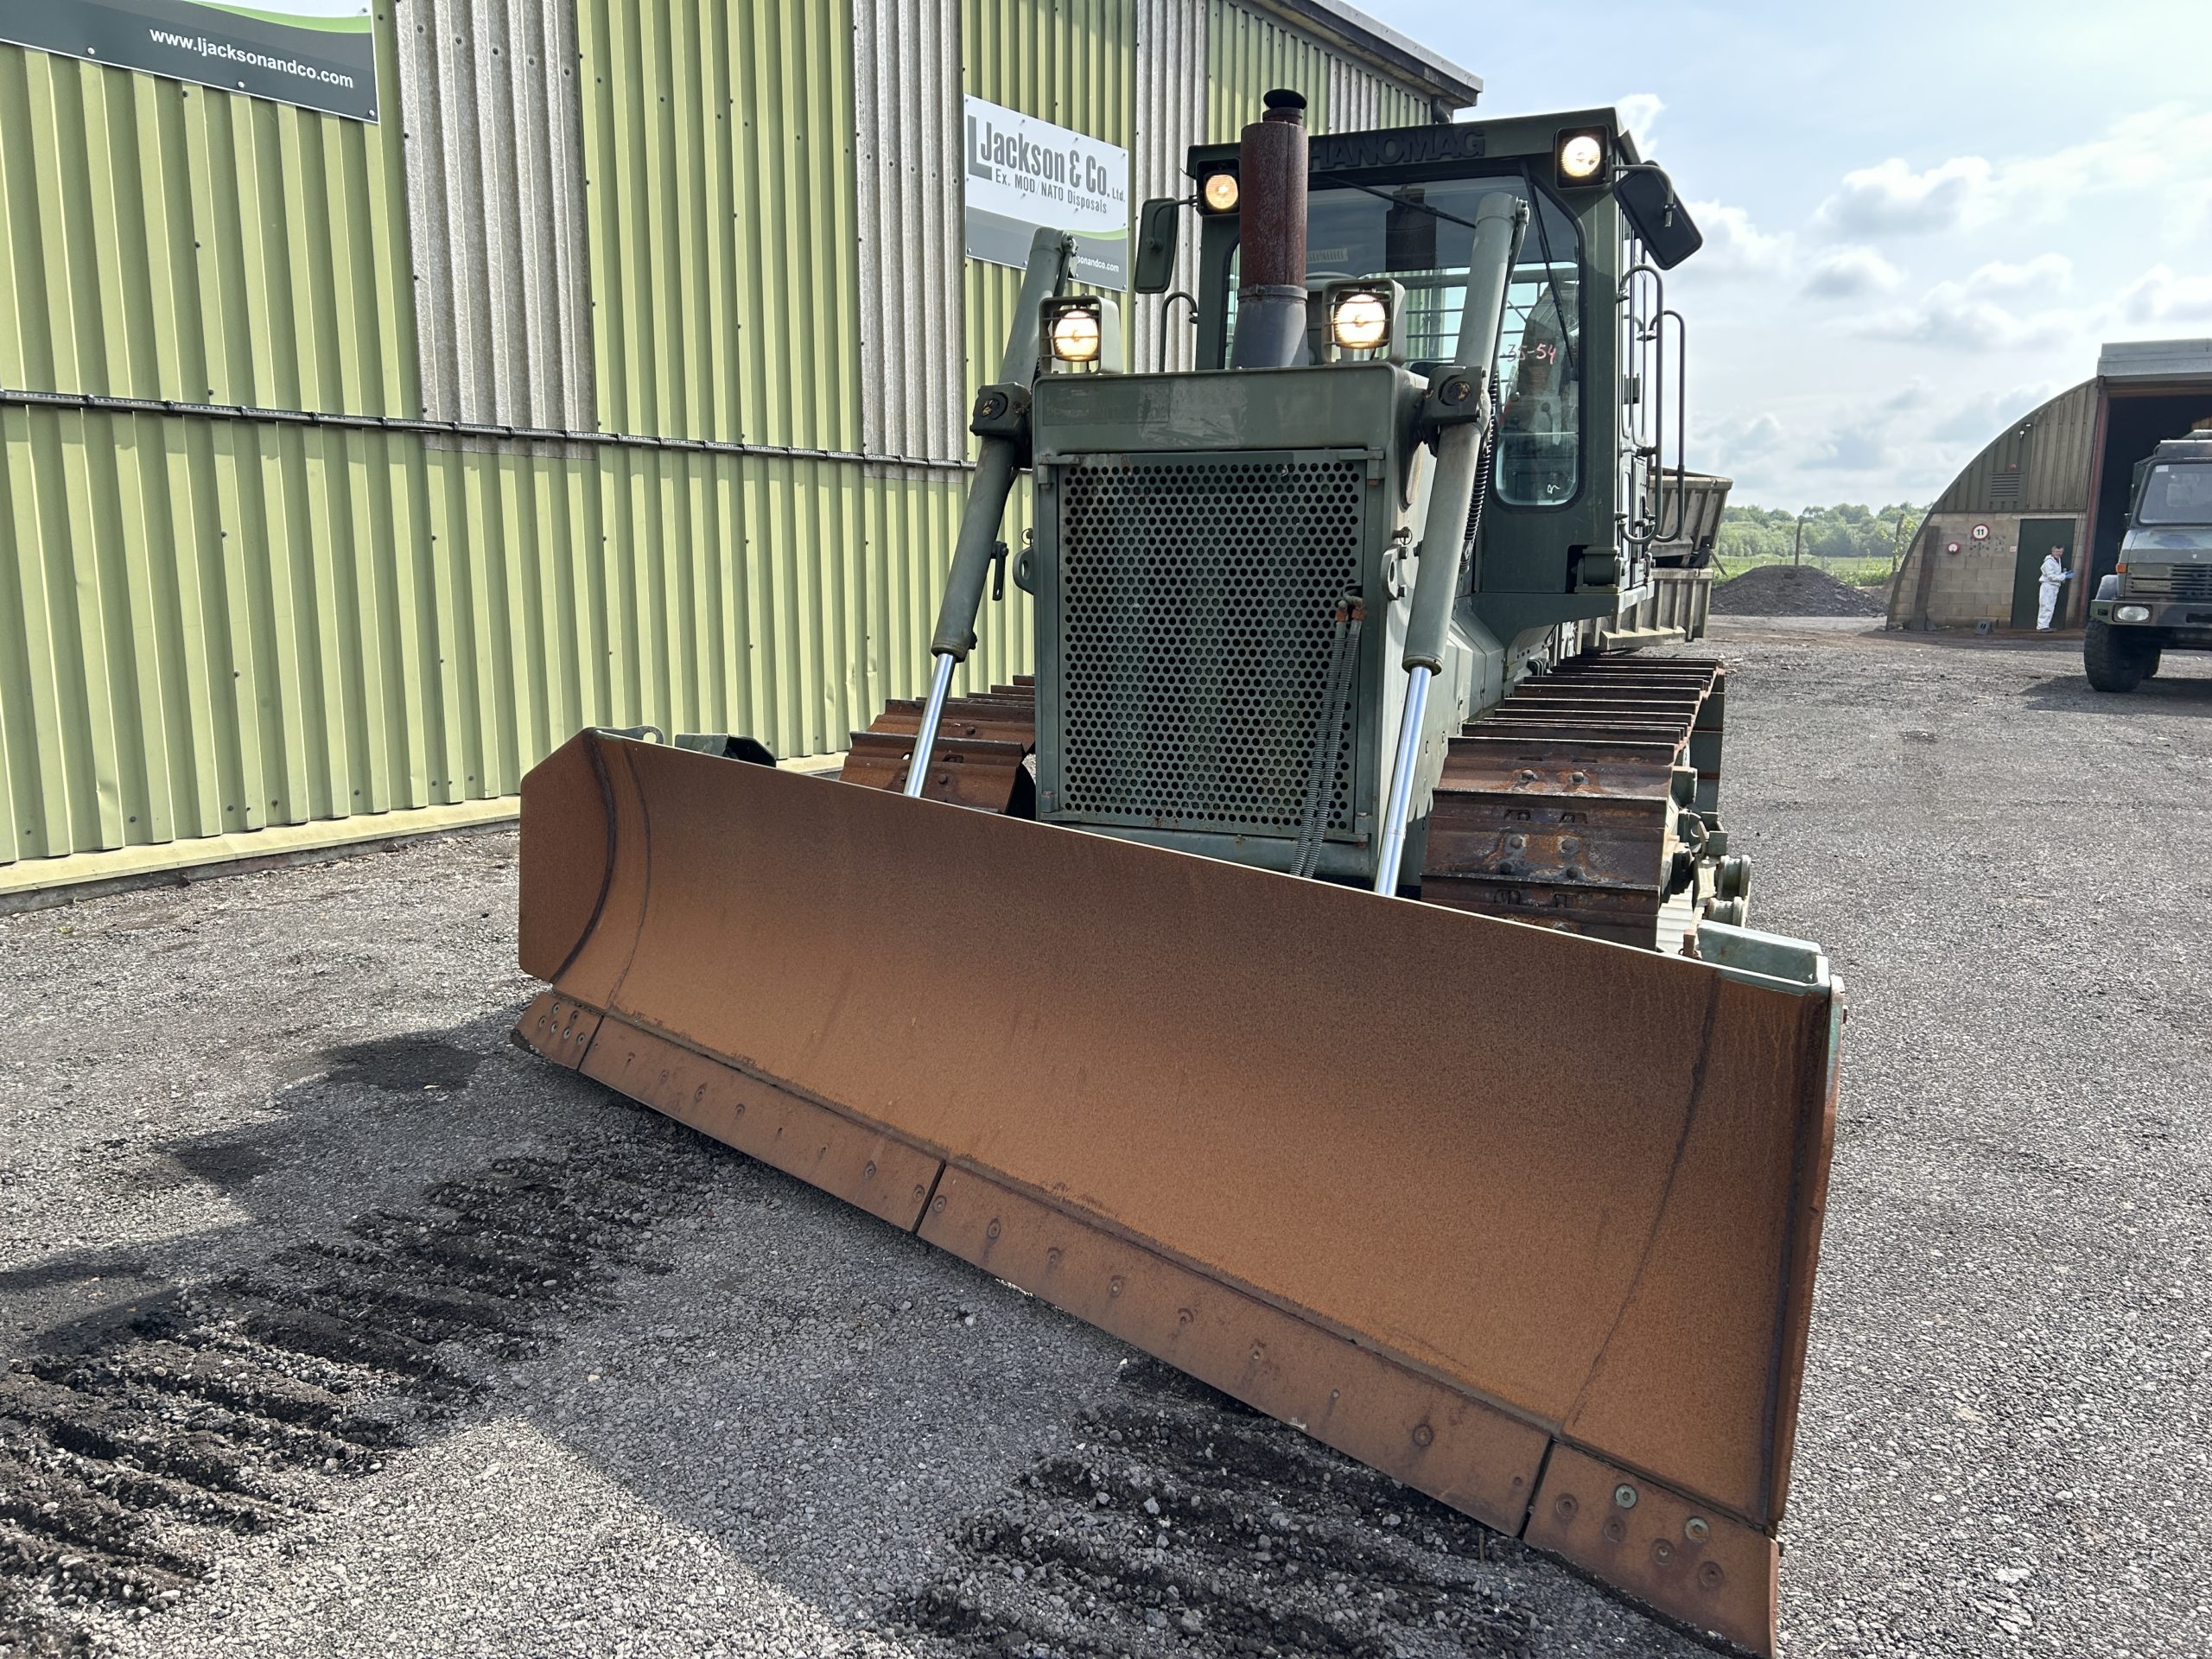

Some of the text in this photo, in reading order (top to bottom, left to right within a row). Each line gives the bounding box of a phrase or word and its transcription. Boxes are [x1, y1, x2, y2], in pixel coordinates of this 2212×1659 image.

[149, 29, 353, 88] www.ljacksonandco.com
[1309, 129, 1485, 170] HANOMAG
[996, 168, 1010, 186] Ex.
[1068, 189, 1106, 213] Disposals
[1070, 149, 1081, 188] &
[1086, 155, 1110, 198] Co.
